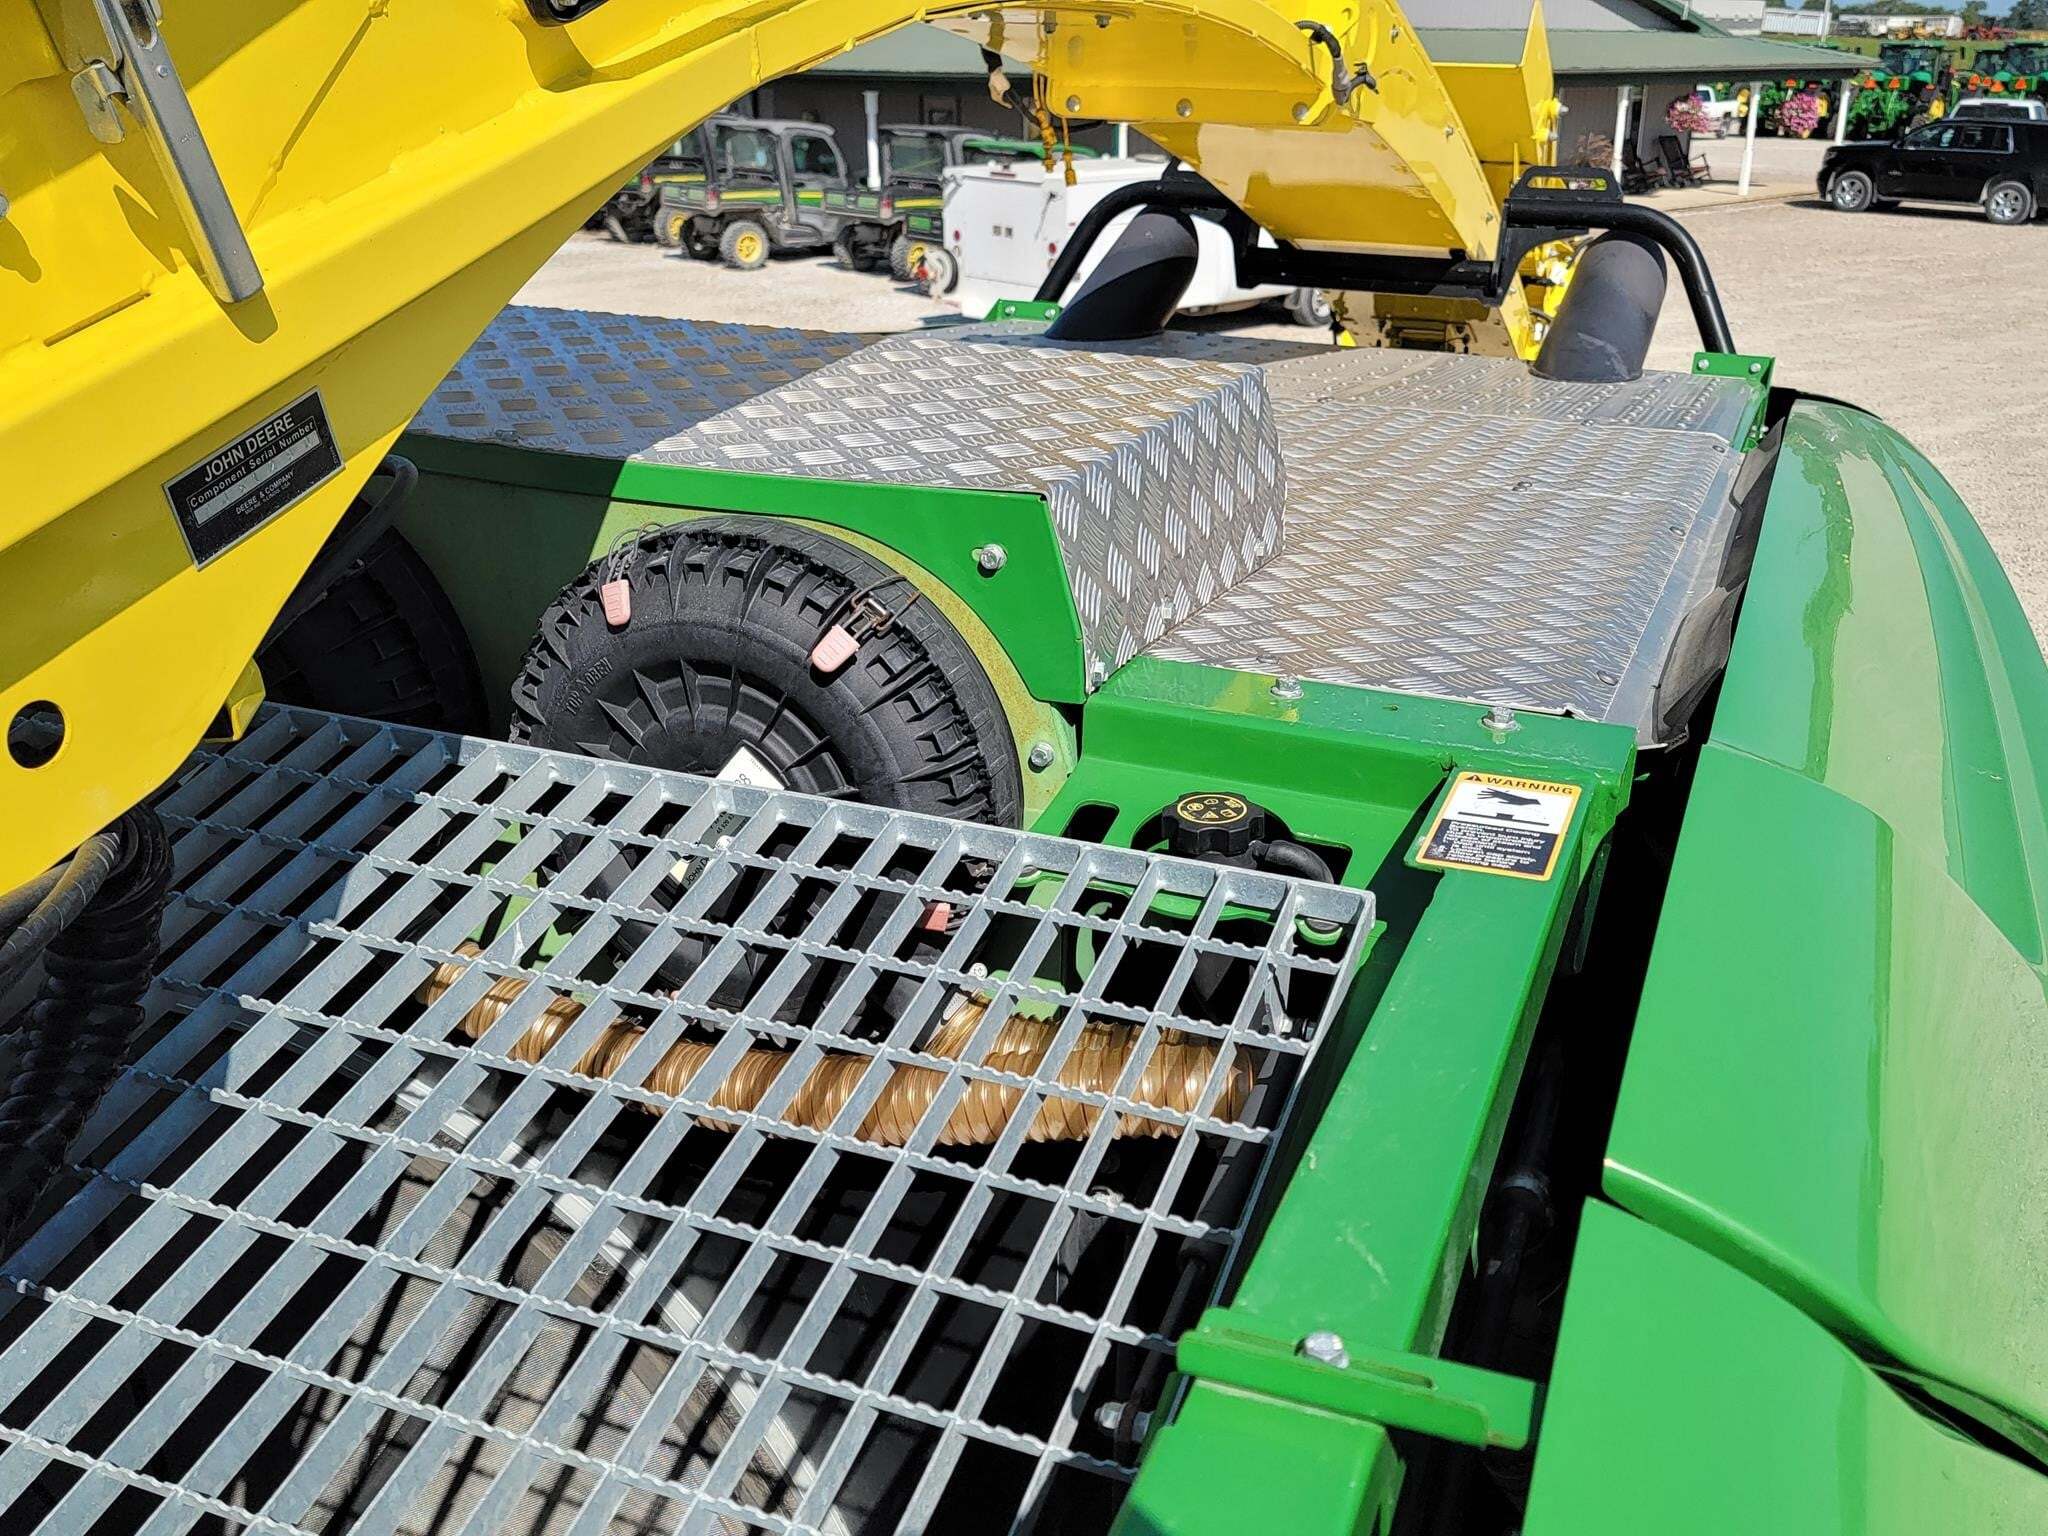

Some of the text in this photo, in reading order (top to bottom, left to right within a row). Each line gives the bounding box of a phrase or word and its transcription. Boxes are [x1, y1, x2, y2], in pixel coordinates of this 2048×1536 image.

[190, 466, 246, 507] Component
[249, 445, 277, 469] Serial
[279, 421, 314, 450] Number
[205, 445, 244, 482] JOHN
[246, 412, 295, 455] DEERE
[236, 496, 258, 515] DEERE
[265, 469, 295, 495] COMPANY
[1486, 777, 1573, 795] WARNING
